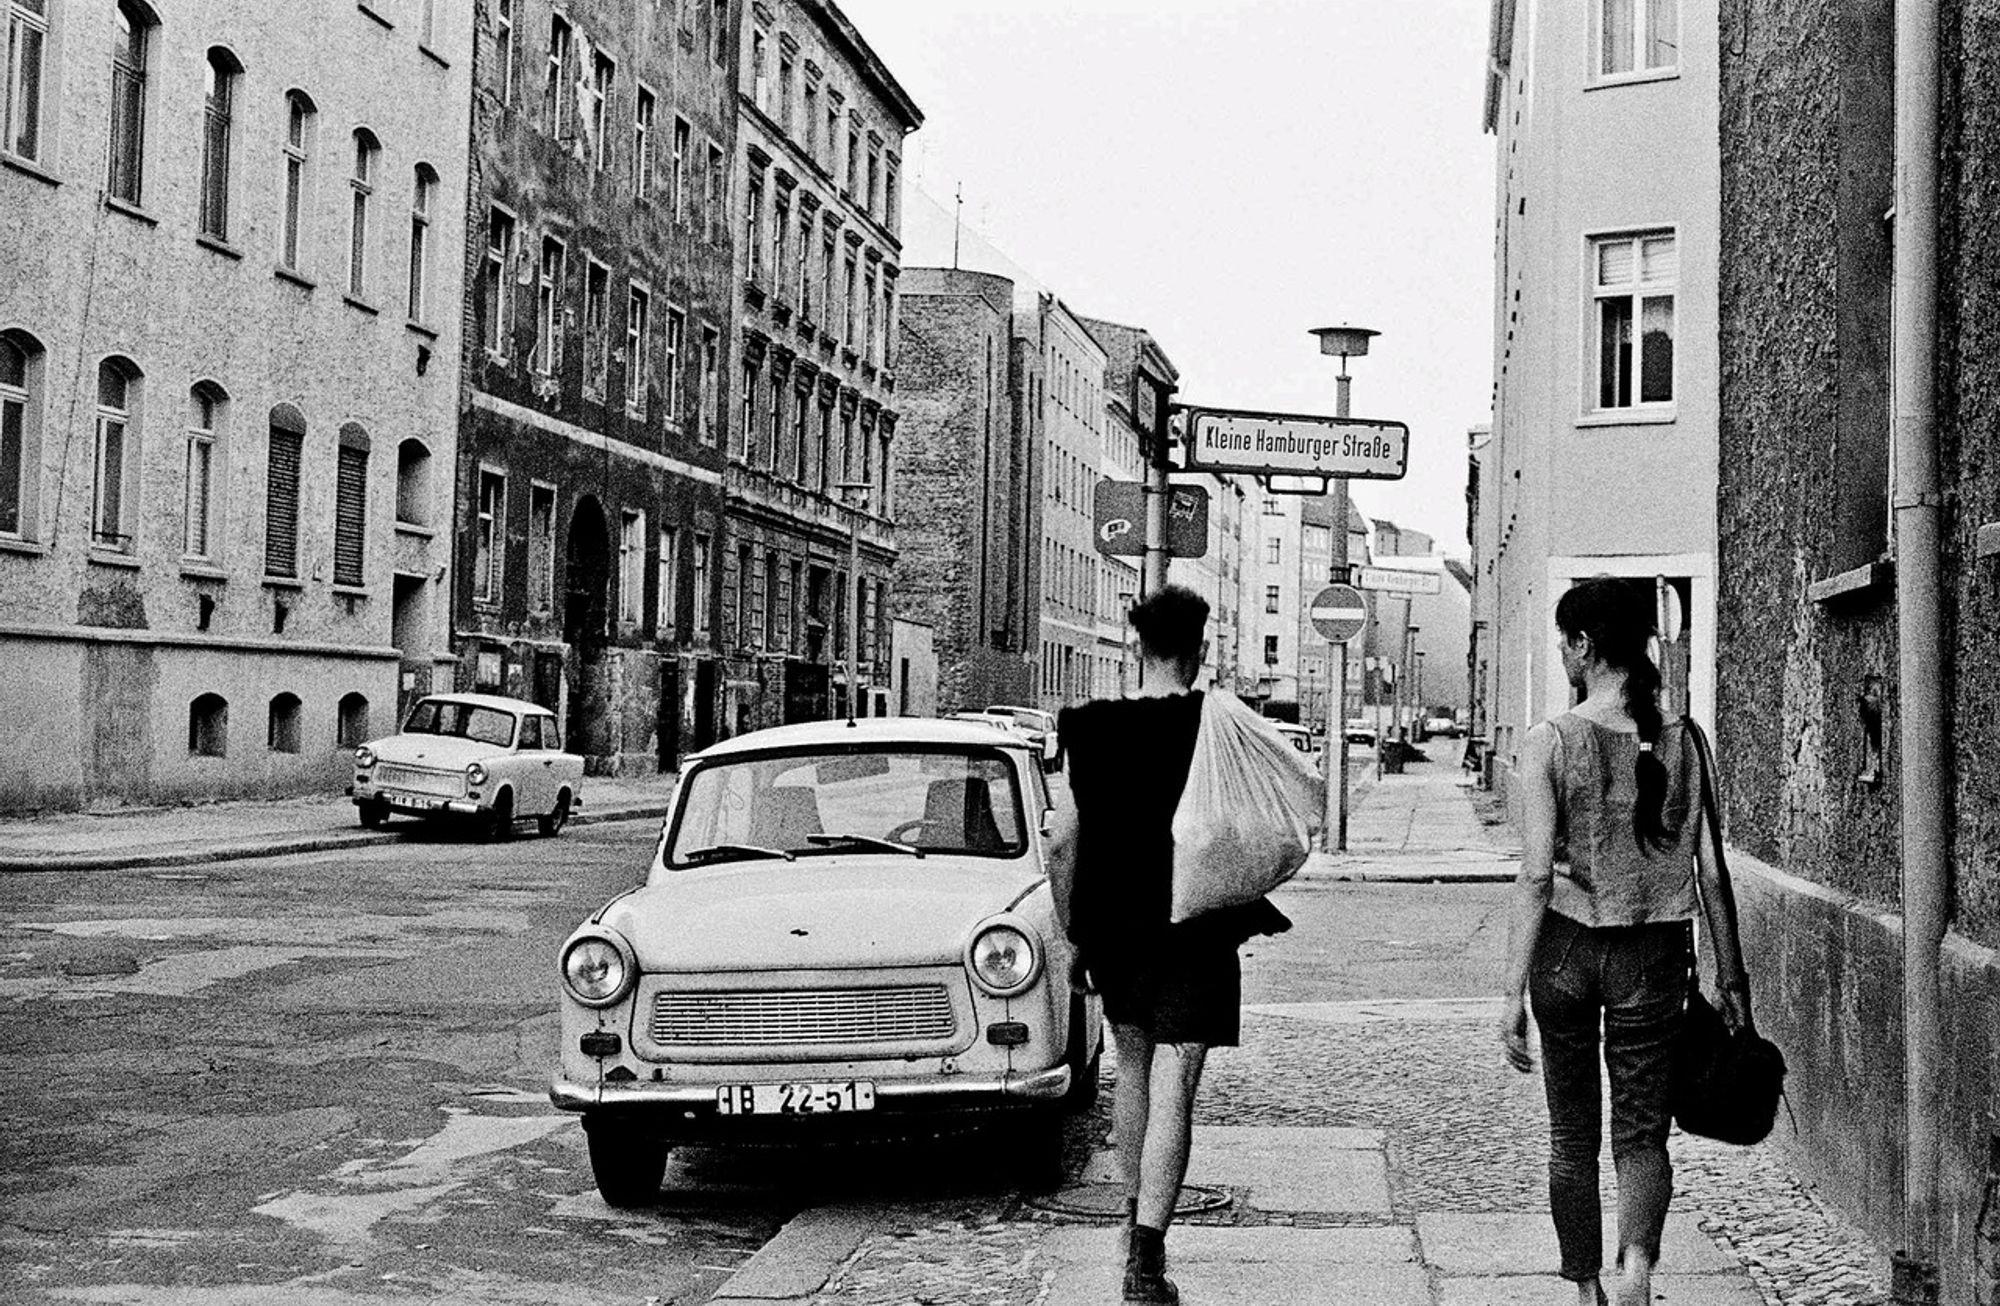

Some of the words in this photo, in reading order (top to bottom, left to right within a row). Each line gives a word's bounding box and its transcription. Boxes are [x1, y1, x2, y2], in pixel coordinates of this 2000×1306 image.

[1205, 425, 1251, 451] Kleine
[1256, 429, 1340, 461] Hamburger
[1342, 434, 1391, 459] Straße
[779, 1082, 857, 1113] 22-51
